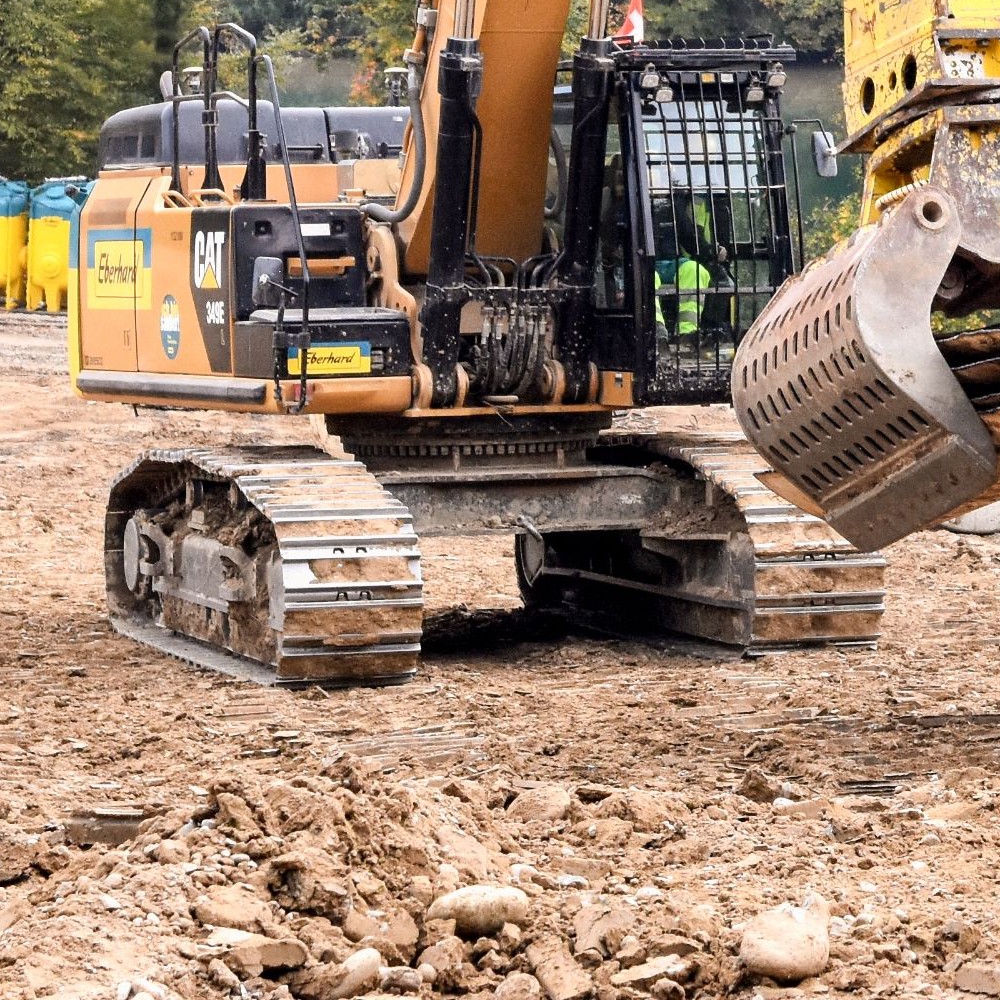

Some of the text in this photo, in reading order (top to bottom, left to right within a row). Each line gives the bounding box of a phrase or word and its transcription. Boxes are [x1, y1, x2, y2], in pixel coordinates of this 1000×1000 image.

[98, 253, 140, 284] Eberhard
[194, 230, 225, 288] CAT
[205, 301, 225, 324] 349E
